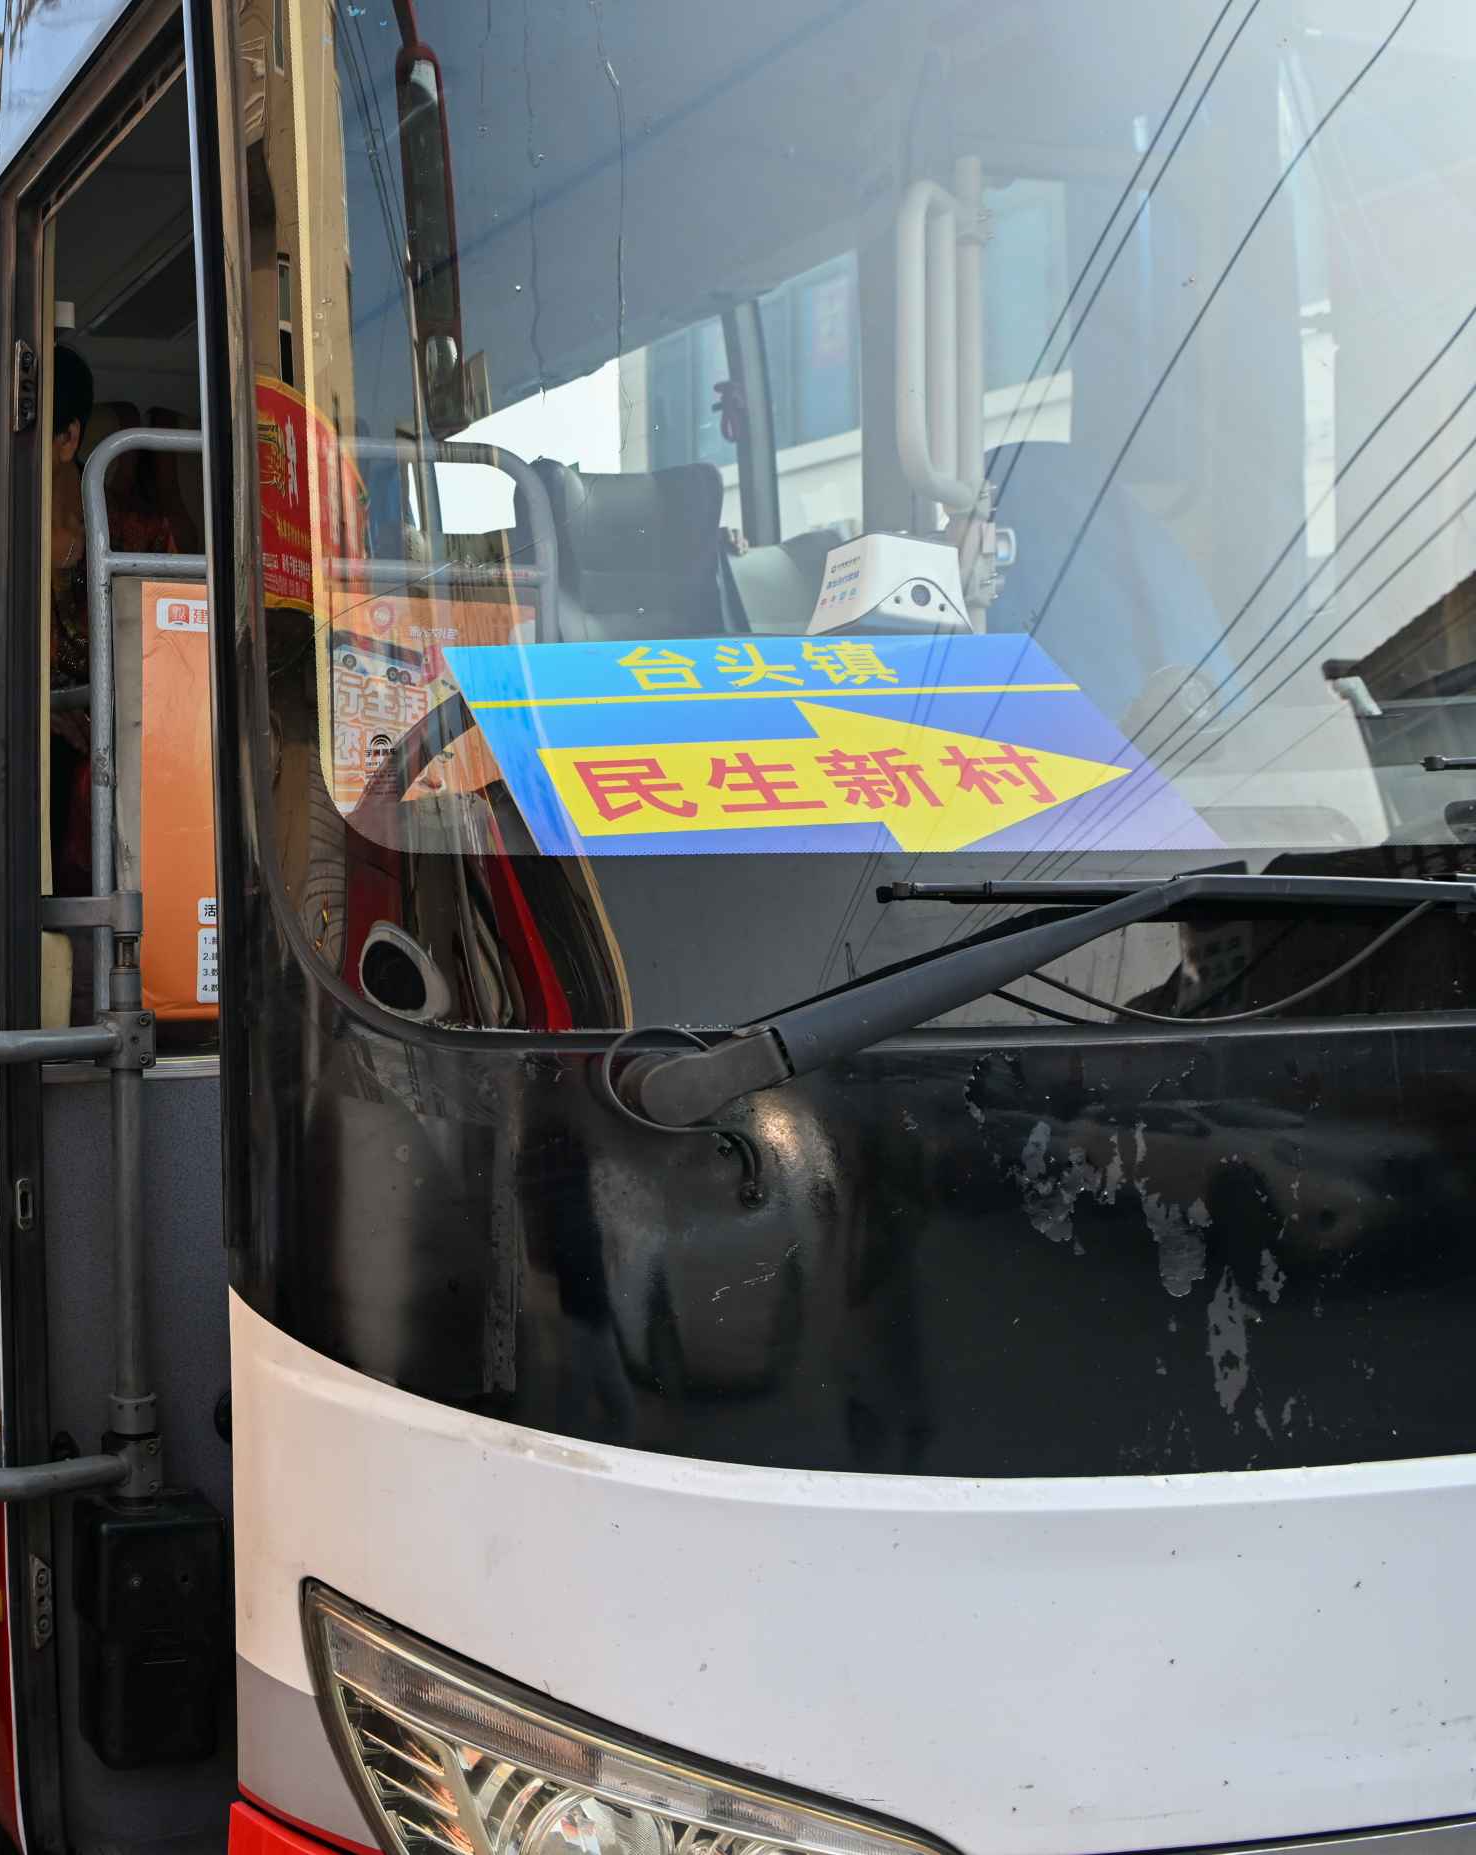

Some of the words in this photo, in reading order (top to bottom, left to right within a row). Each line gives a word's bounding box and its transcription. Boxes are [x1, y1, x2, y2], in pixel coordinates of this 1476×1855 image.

[617, 641, 900, 690] 台头镇
[572, 744, 1058, 821] 民生新村
